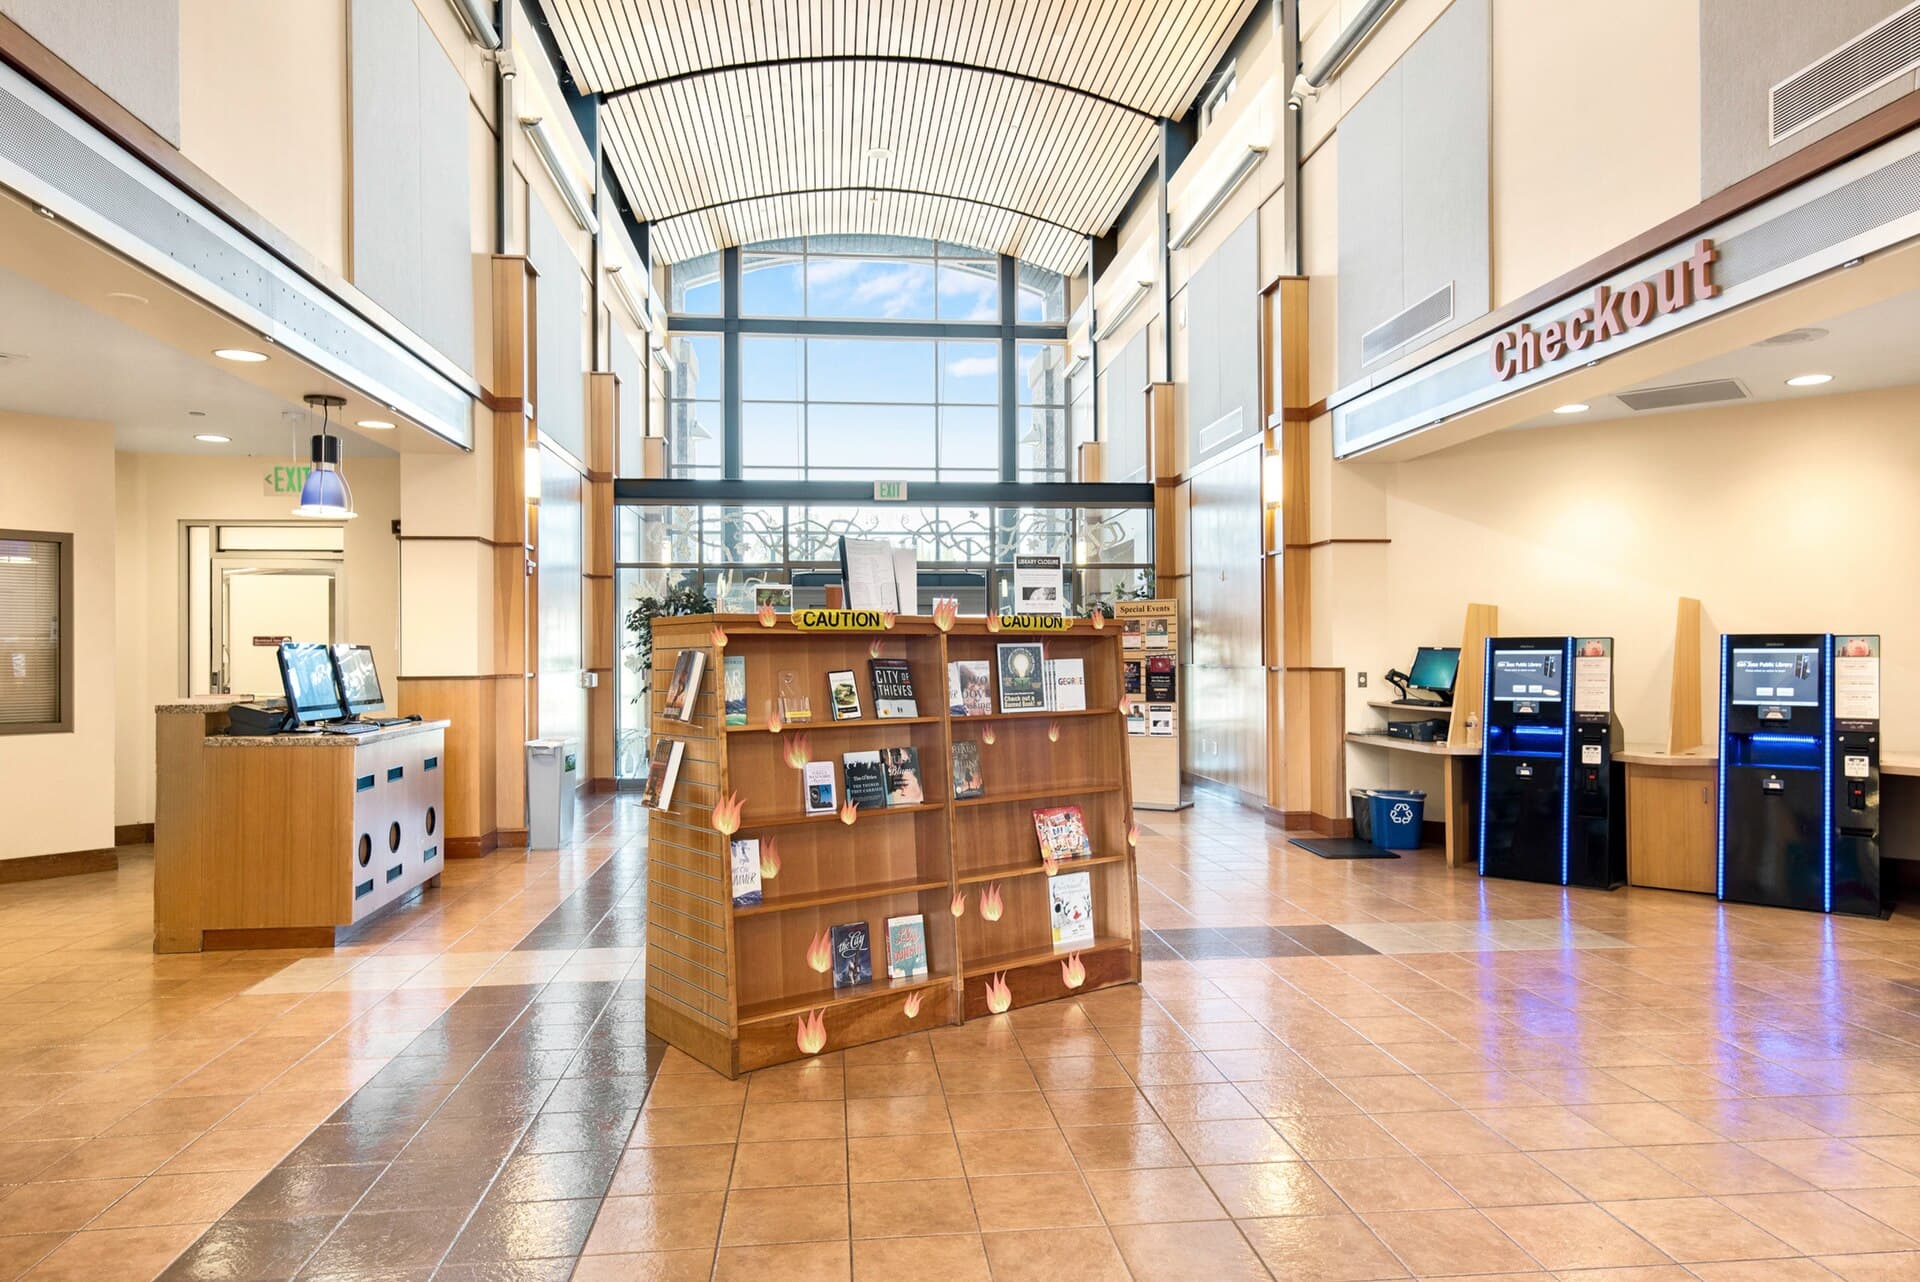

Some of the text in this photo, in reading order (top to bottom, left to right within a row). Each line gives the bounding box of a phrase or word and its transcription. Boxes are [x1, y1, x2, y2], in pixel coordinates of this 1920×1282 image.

[1489, 238, 1720, 381] Checkout
[274, 466, 311, 492] EXIT
[880, 482, 900, 498] EXIT
[1120, 605, 1145, 614] Special
[803, 611, 879, 627] CAUTION
[1001, 615, 1063, 628] CAUTION
[875, 670, 910, 684] CITY OF
[878, 684, 913, 697] THIEVES
[849, 931, 866, 951] Cay
